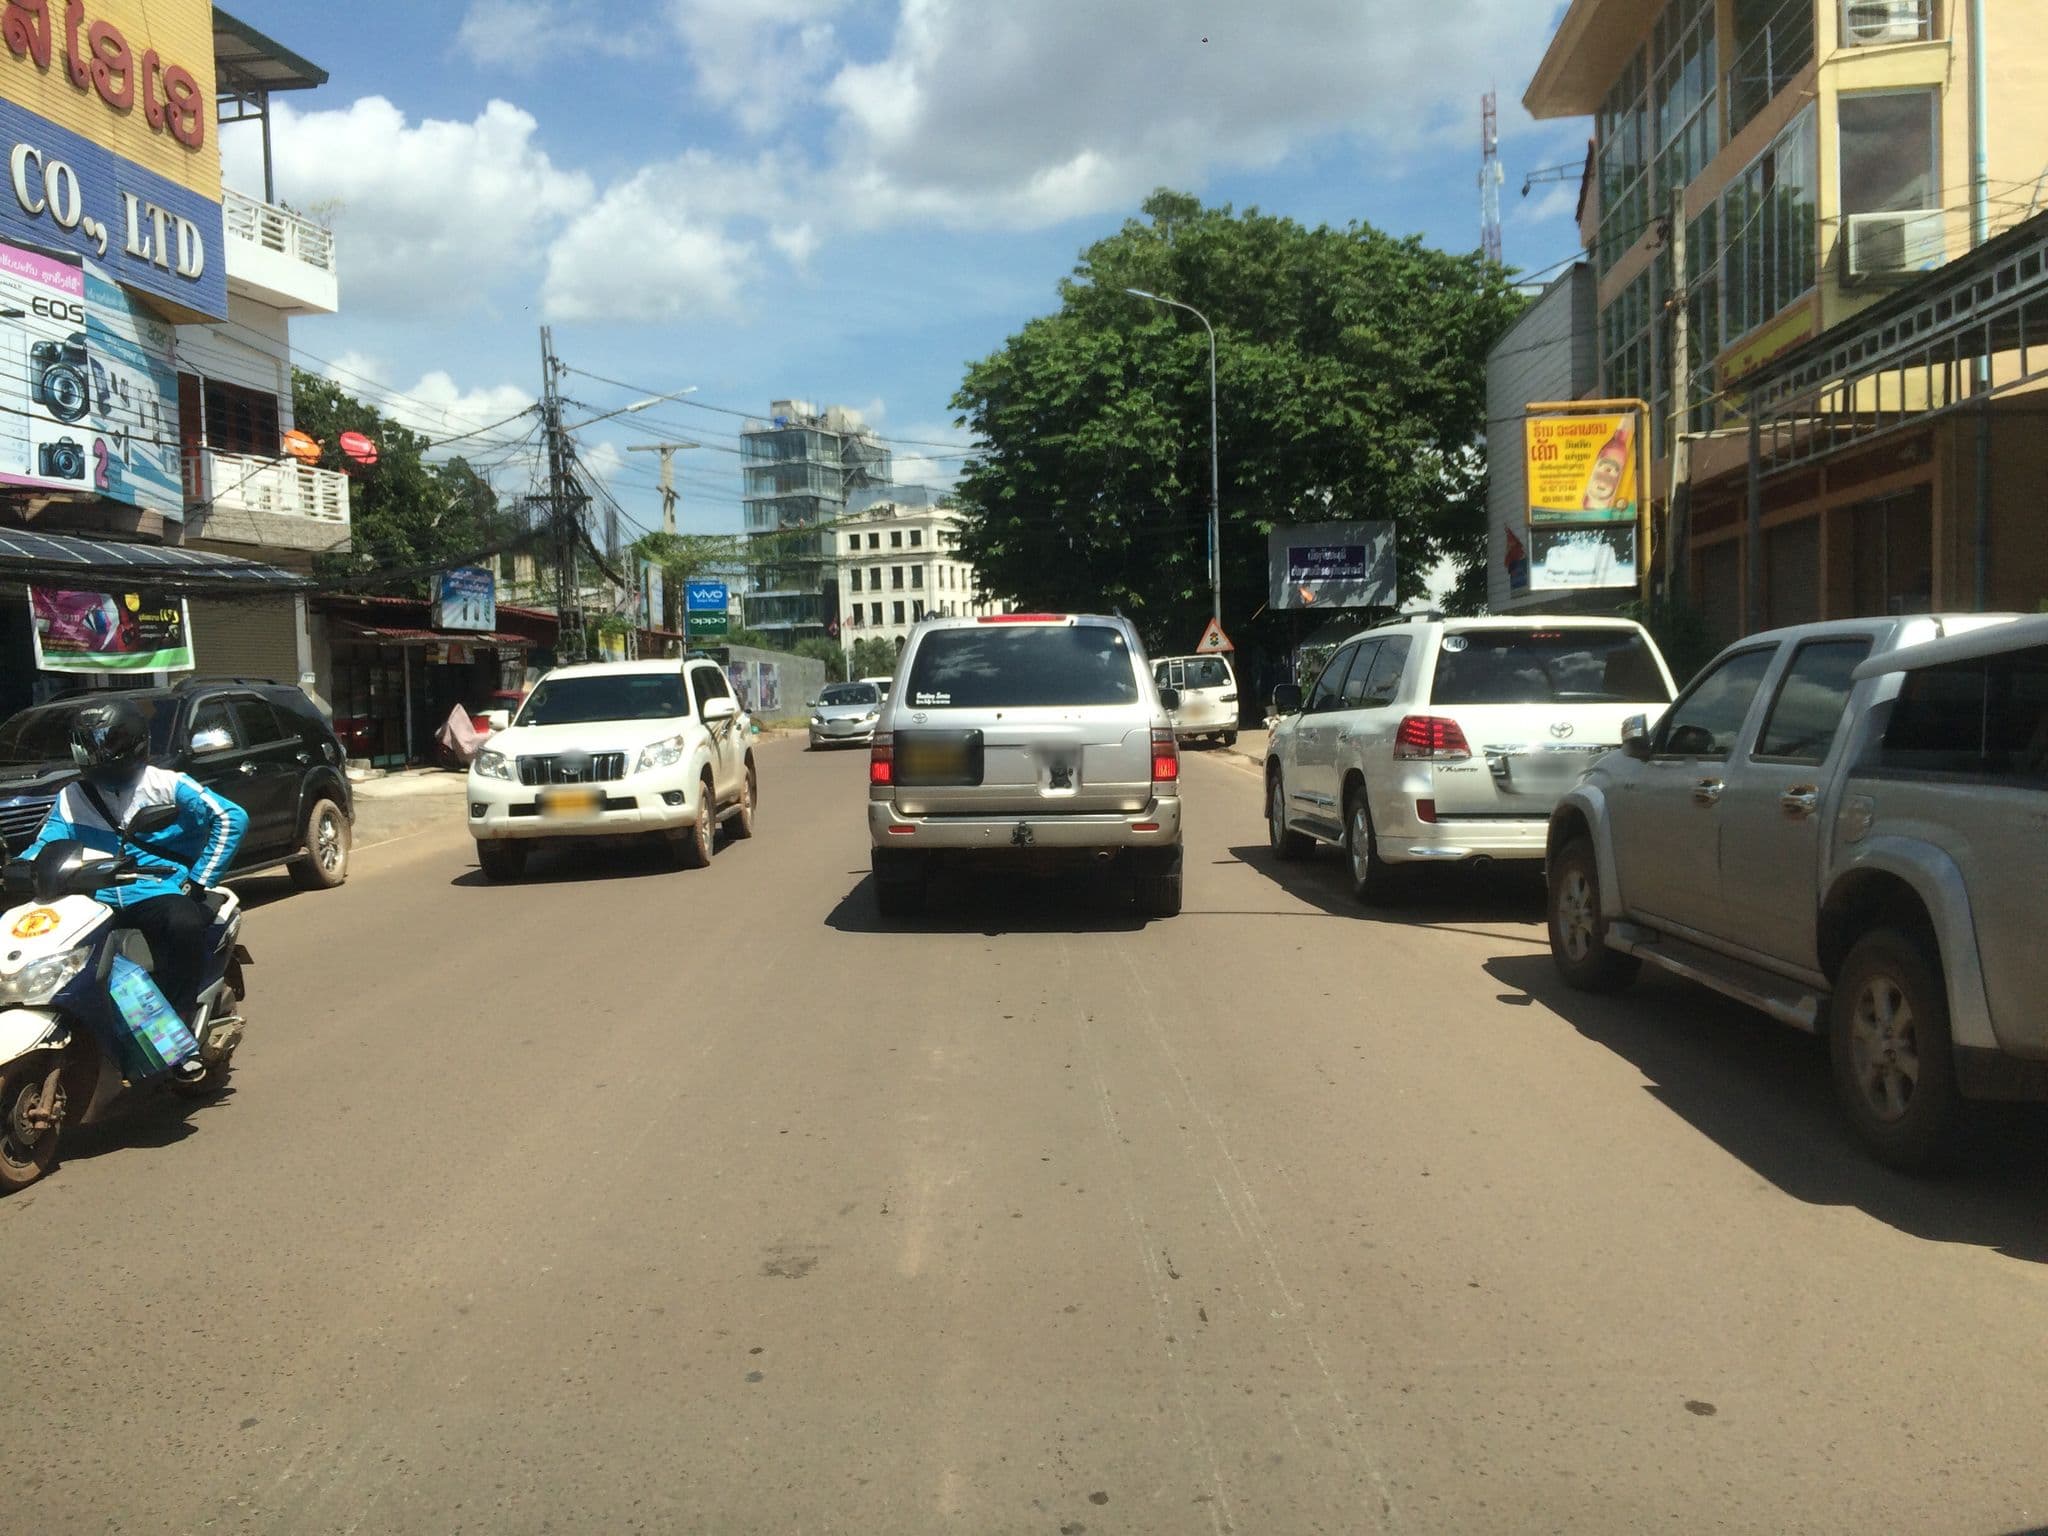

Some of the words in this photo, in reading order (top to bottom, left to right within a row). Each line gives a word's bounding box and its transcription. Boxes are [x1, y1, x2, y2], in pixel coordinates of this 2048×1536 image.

[11, 143, 107, 256] CO.,
[123, 191, 204, 279] LTD
[32, 295, 85, 324] EOS
[692, 589, 723, 599] vivo
